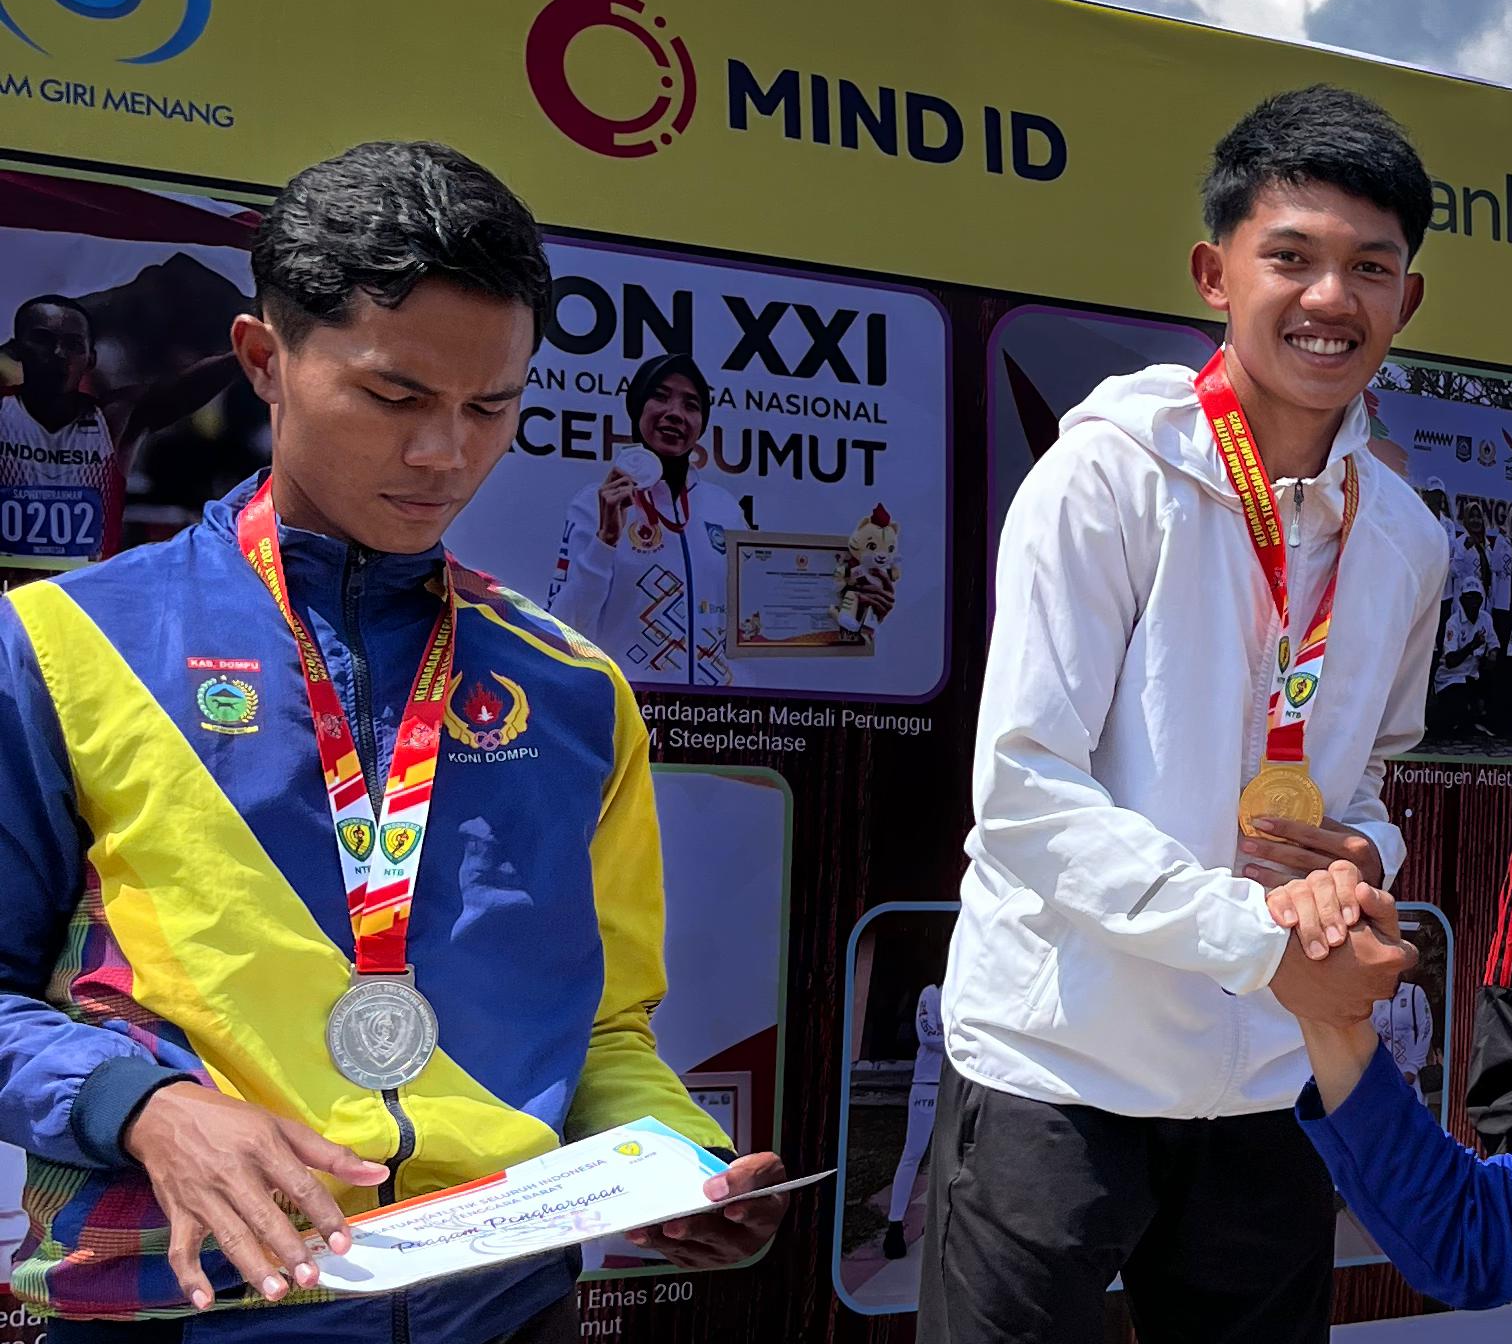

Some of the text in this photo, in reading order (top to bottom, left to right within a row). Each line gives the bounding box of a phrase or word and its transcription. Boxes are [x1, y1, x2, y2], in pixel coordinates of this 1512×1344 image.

[40, 78, 95, 107] GIRI
[102, 87, 235, 128] MENANG
[727, 58, 1067, 181] MIND ID
[721, 294, 887, 386] XXI
[746, 389, 887, 425] NASIONAL
[1212, 416, 1236, 452] ATLETIK
[1226, 452, 1249, 492] DAERAH
[1226, 410, 1281, 546] NUSA TENGGARA BARAT 2025
[2, 500, 95, 545] 0202
[219, 660, 259, 669] DOMPU
[769, 705, 836, 728] Medali
[842, 709, 932, 736] Perunggu
[448, 747, 540, 764] KONI DOMPU
[669, 728, 807, 753] Steeplechase
[1394, 764, 1472, 786] Kontingen
[384, 868, 405, 877] NTB
[480, 1182, 538, 1204] SELURUH
[538, 1158, 608, 1186] INDONESIA
[522, 1183, 564, 1202] BARAT
[589, 1288, 648, 1309] Emas
[654, 1282, 693, 1304] 200
[580, 1315, 622, 1337] mut
